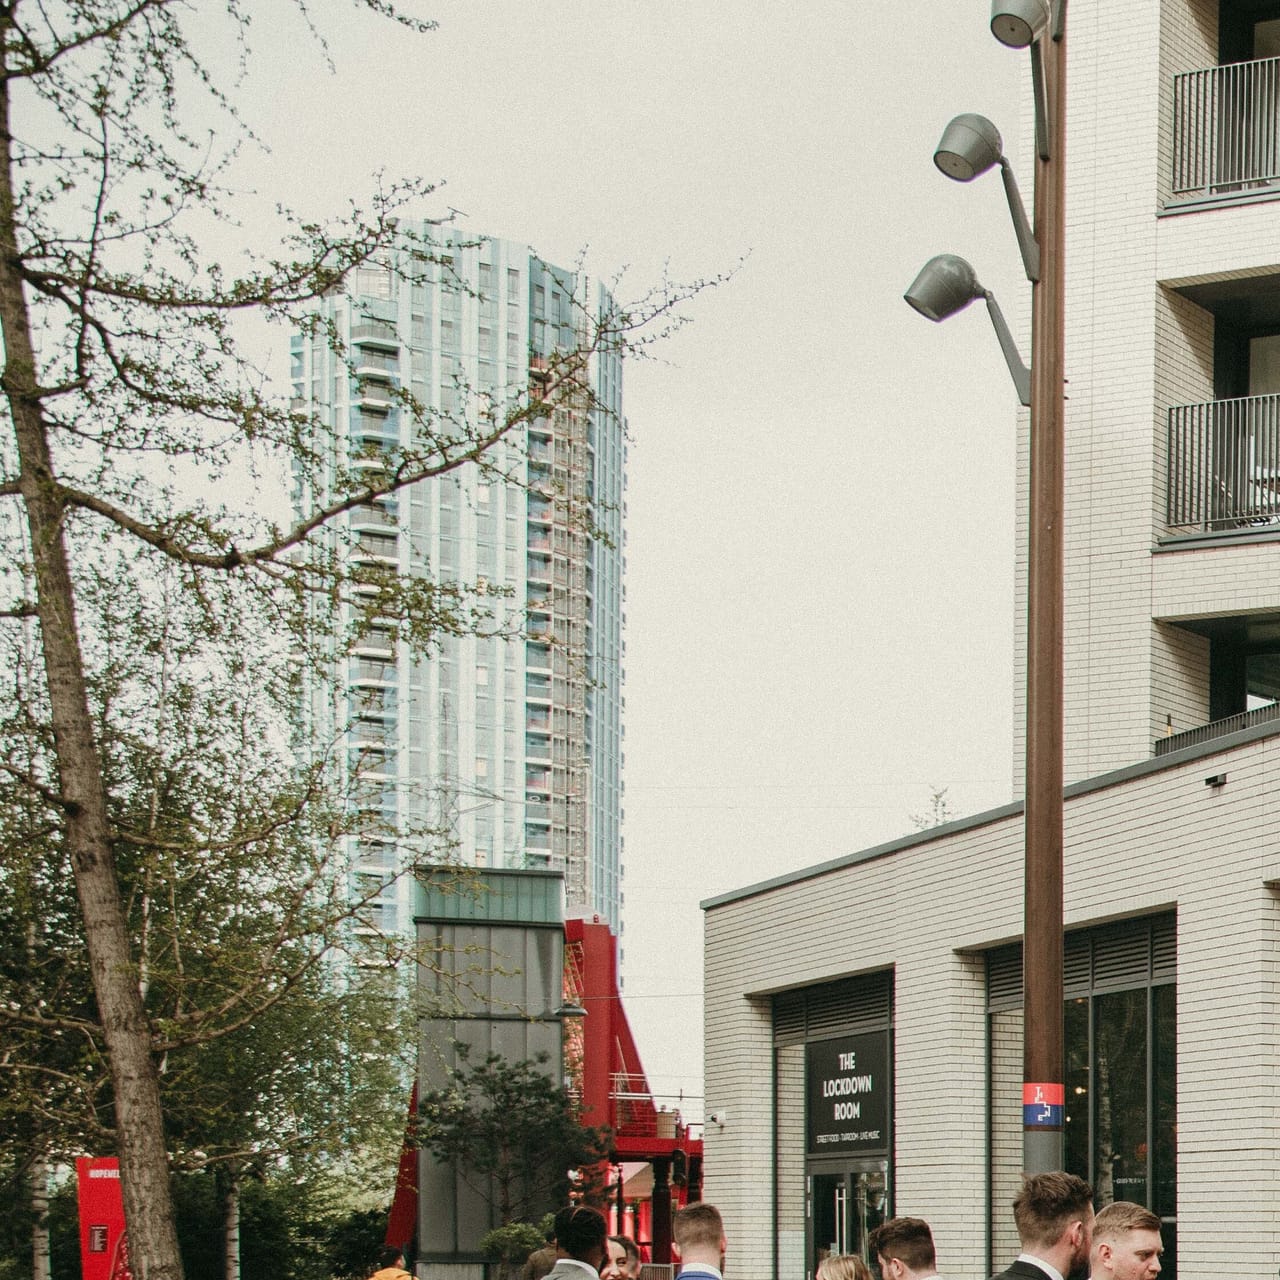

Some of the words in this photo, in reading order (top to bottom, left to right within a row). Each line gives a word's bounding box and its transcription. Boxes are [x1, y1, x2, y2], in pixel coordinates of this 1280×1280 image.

[839, 1052, 855, 1070] THE
[823, 1075, 872, 1097] LOCKDOWN
[834, 1102, 860, 1120] ROOM
